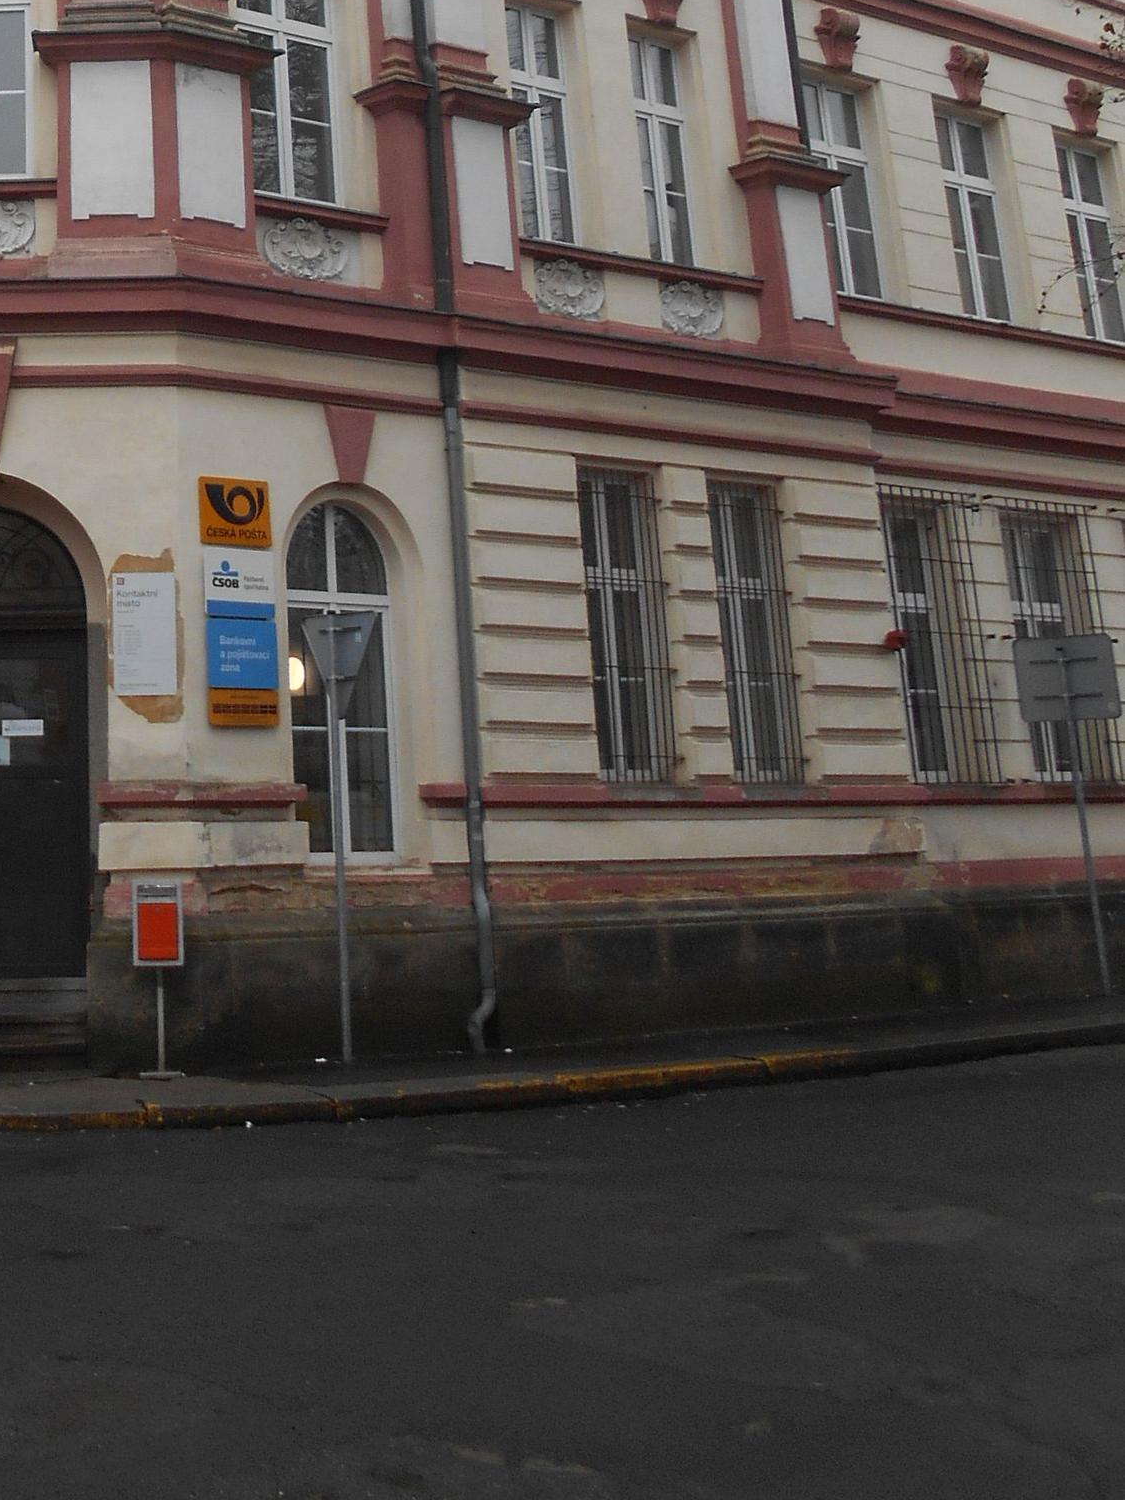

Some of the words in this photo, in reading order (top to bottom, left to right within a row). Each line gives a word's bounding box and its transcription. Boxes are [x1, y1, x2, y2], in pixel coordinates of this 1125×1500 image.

[206, 525, 236, 539] ČESKÁ
[239, 527, 268, 541] POŠTA
[212, 576, 240, 588] ČSOB
[117, 588, 158, 598] Kontaktní
[219, 635, 256, 646] Bankovní
[219, 650, 226, 659] a
